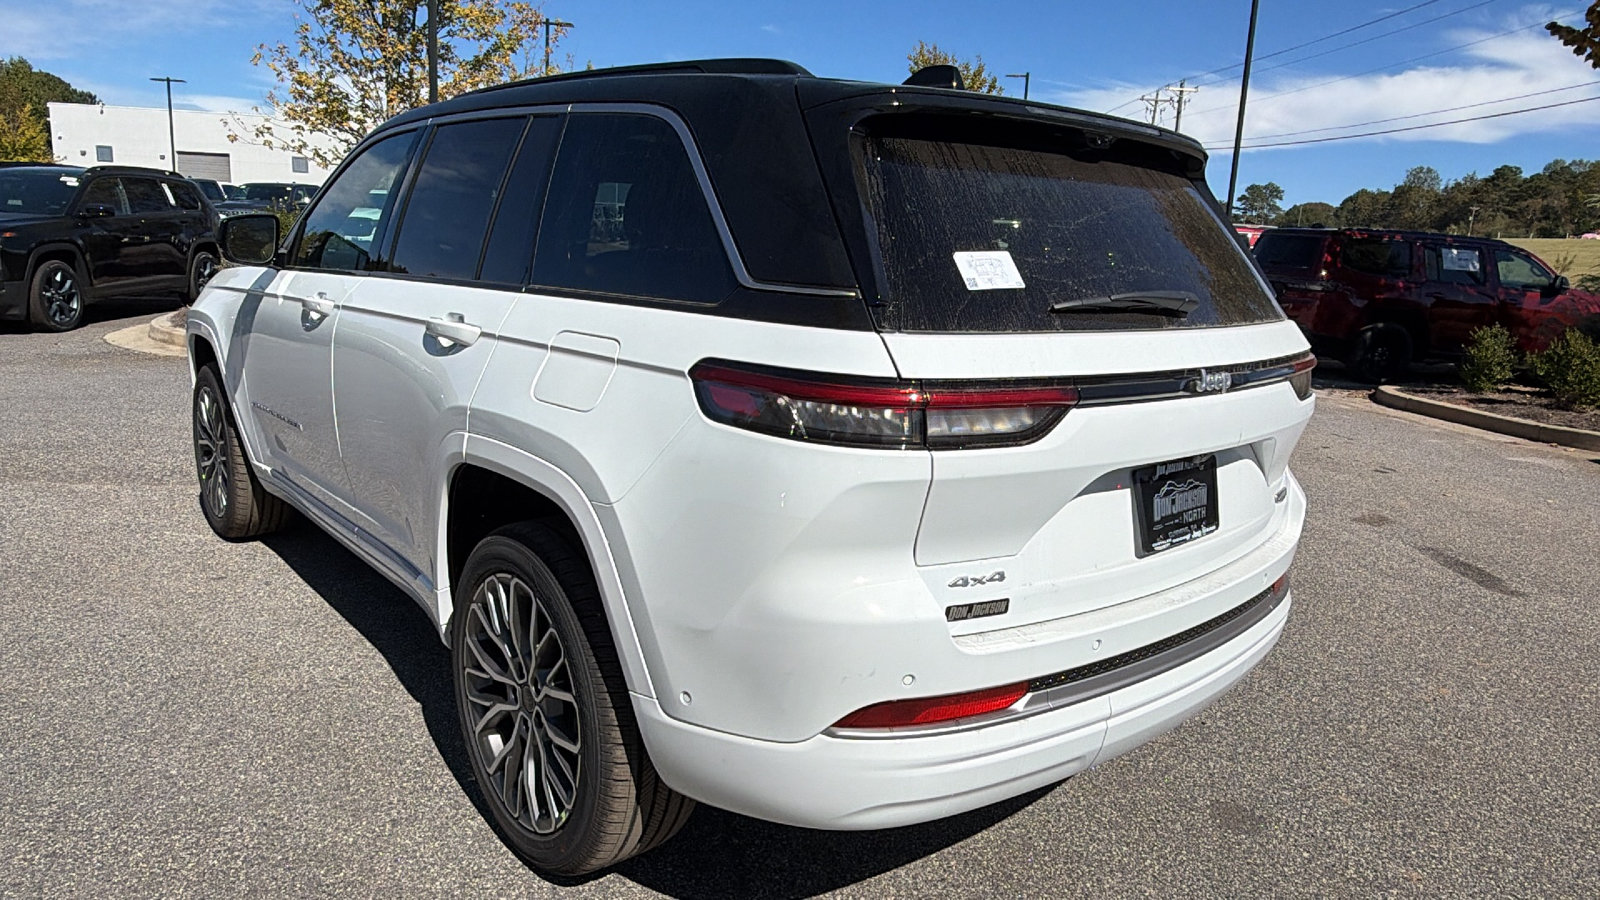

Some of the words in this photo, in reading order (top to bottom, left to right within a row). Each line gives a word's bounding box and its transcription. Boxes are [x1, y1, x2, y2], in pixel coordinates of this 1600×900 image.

[1196, 369, 1231, 393] Jeep
[1153, 496, 1172, 522] DON
[1172, 484, 1208, 514] JACKSON
[1183, 506, 1207, 524] NORTH
[948, 571, 1006, 588] 4x4
[948, 606, 969, 620] DON
[967, 600, 1008, 618] JACKSON
